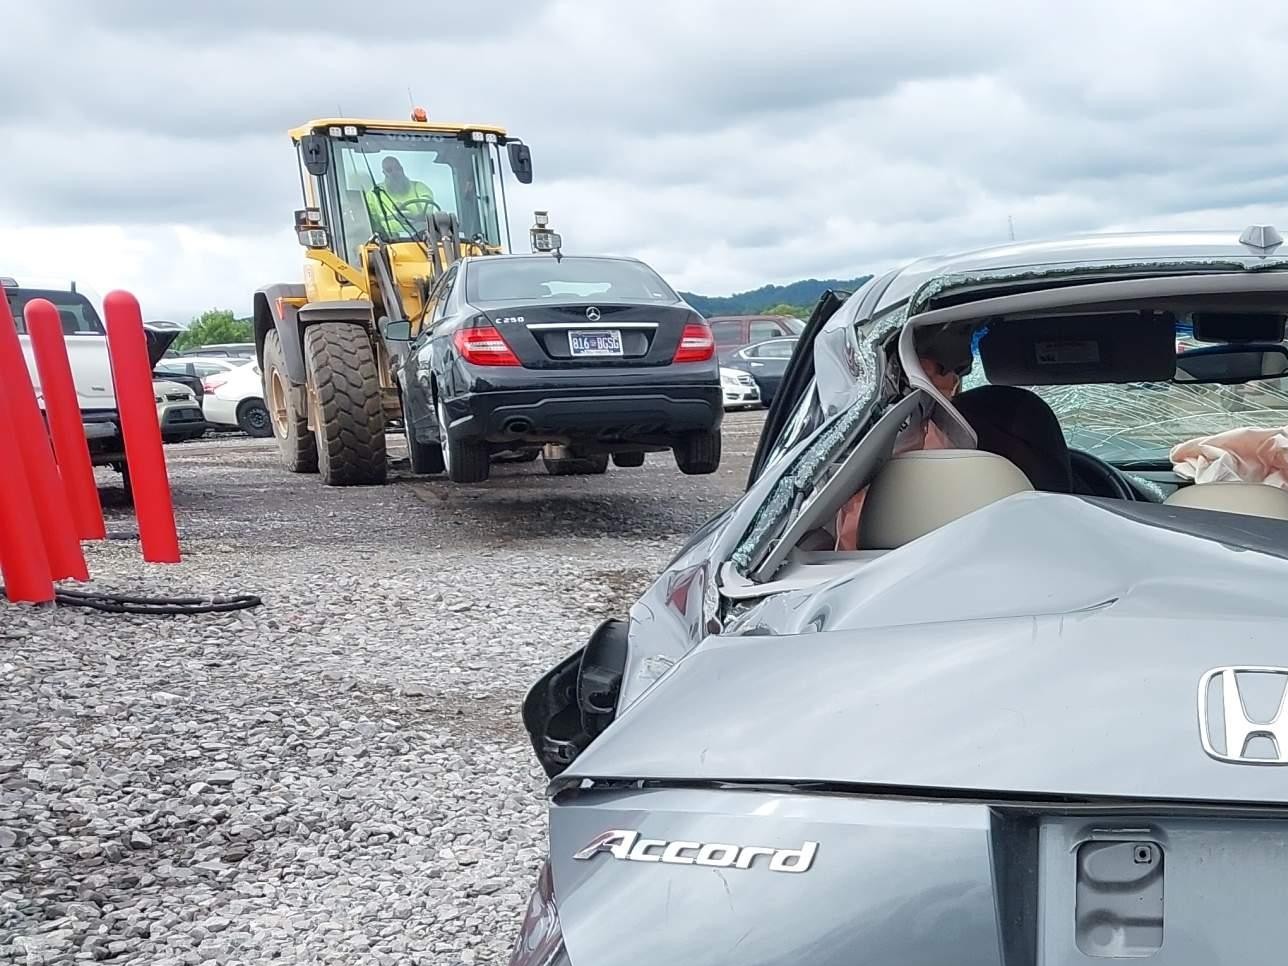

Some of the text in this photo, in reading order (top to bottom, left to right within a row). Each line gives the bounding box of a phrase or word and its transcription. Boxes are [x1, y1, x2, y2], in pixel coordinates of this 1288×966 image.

[572, 337, 620, 350] 816 BGSG
[573, 829, 819, 873] Accord
